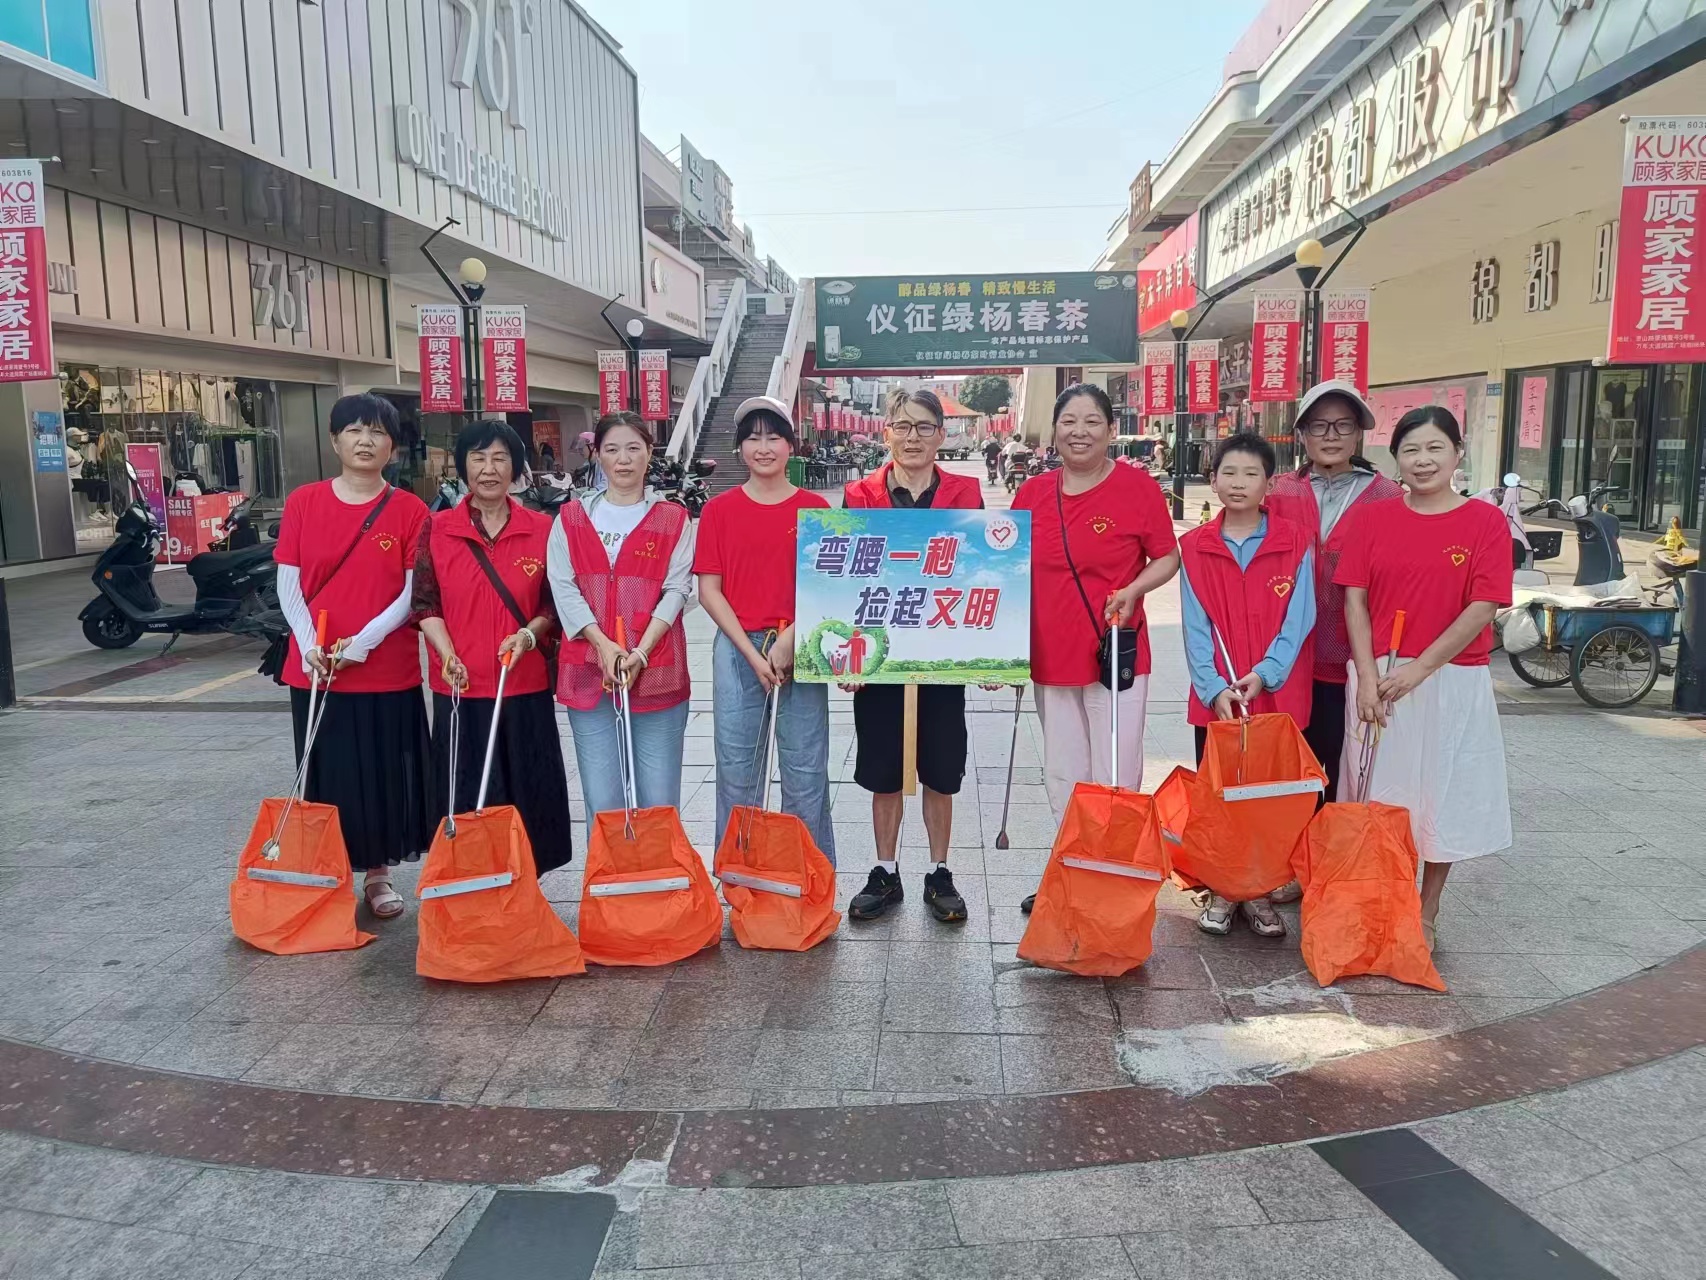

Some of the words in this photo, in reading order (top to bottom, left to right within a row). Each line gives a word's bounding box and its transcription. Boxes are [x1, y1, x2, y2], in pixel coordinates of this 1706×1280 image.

[1303, 0, 1594, 217] 锦都服饰
[399, 104, 449, 181] ONE
[449, 131, 518, 217] DEGREE
[517, 175, 571, 242] BEYOND
[982, 280, 1057, 296] 精致慢生活
[1636, 189, 1699, 331] 顾家家居
[866, 299, 1089, 335] 仪征绿杨春茶
[428, 337, 452, 400] 顾家家居
[494, 339, 517, 402] 顾家家居
[1261, 323, 1288, 389] 顾家家居
[168, 499, 192, 509] SALE
[815, 536, 959, 577] 弯腰一秒
[854, 586, 1001, 629] 捡起文明
